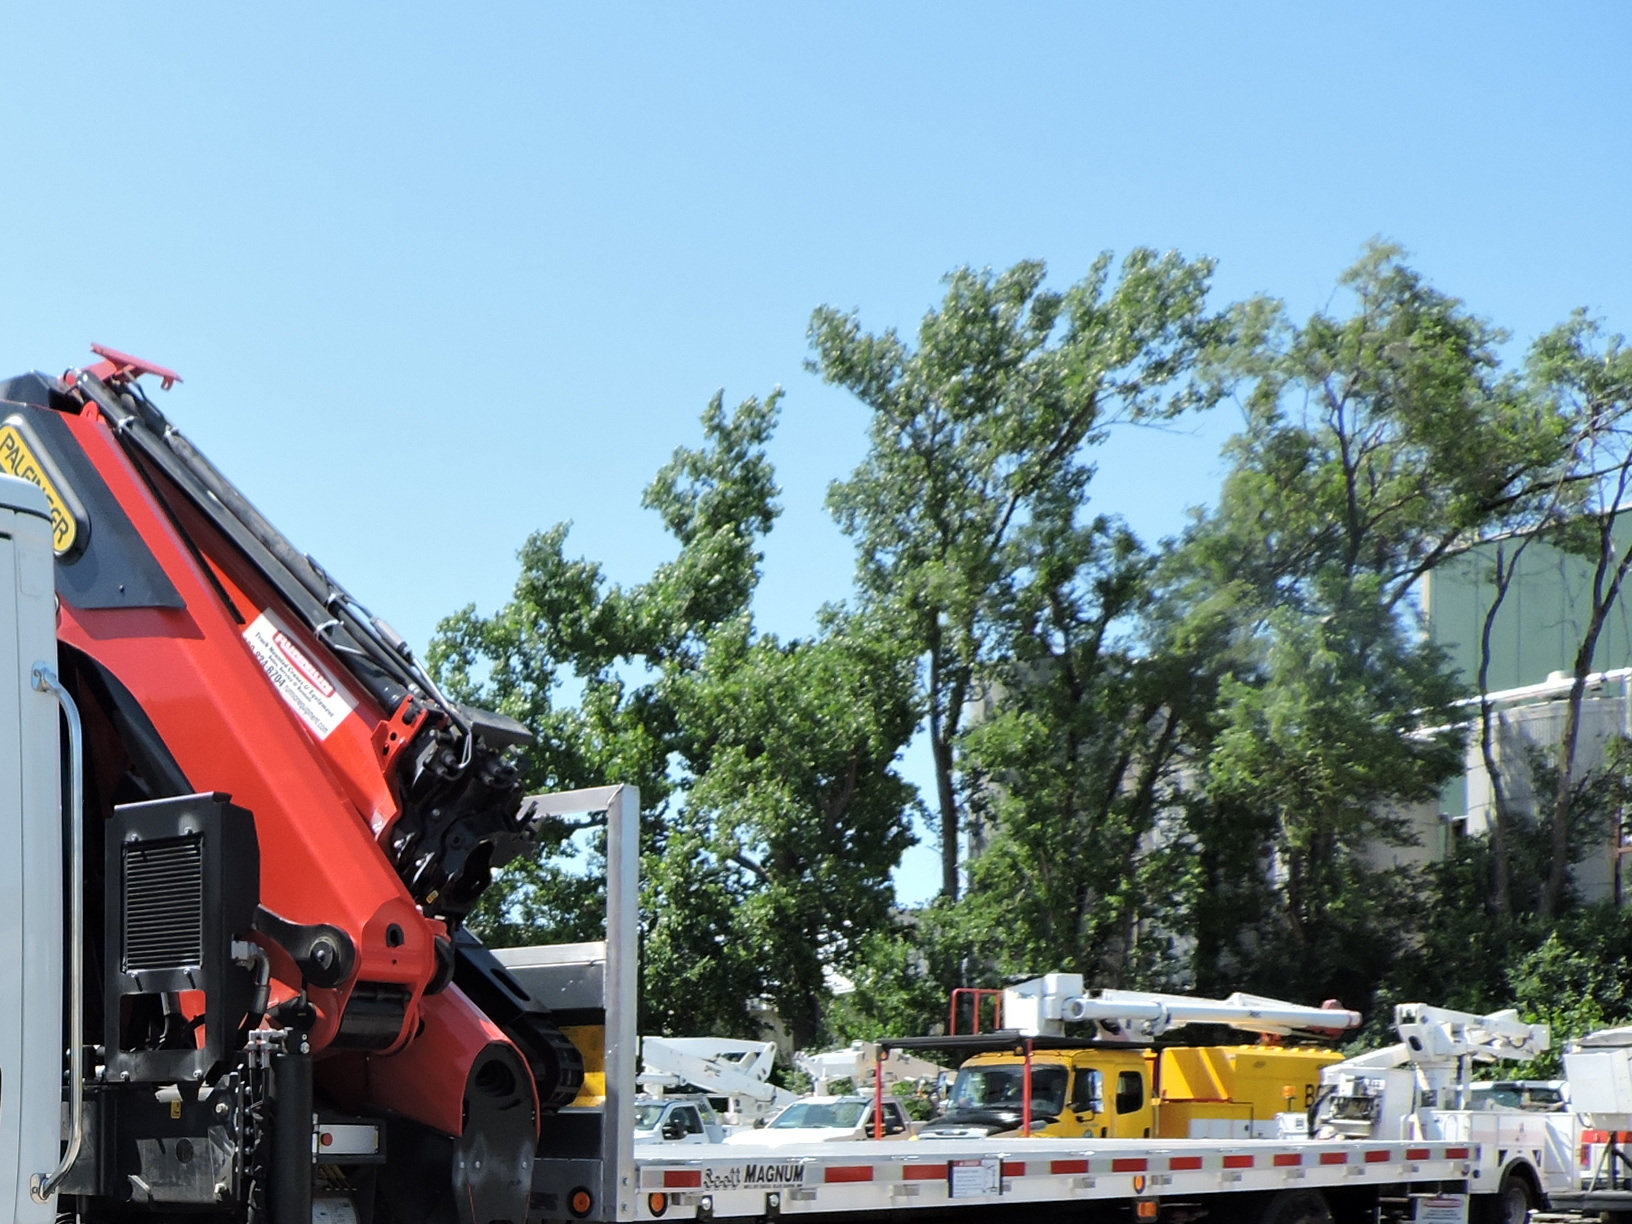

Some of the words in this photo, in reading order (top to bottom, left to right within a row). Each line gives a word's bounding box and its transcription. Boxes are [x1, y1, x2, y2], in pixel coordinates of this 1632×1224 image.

[0, 432, 70, 544] PALFIER
[254, 631, 270, 649] Truck
[269, 645, 289, 669] Mounted
[287, 662, 304, 686] Cranes
[308, 689, 335, 718] Equipment
[274, 632, 335, 696] RUNNION
[283, 684, 329, 734] runnionequipment.com
[703, 1167, 741, 1190] Scott
[743, 1164, 805, 1183] MAGNUM
